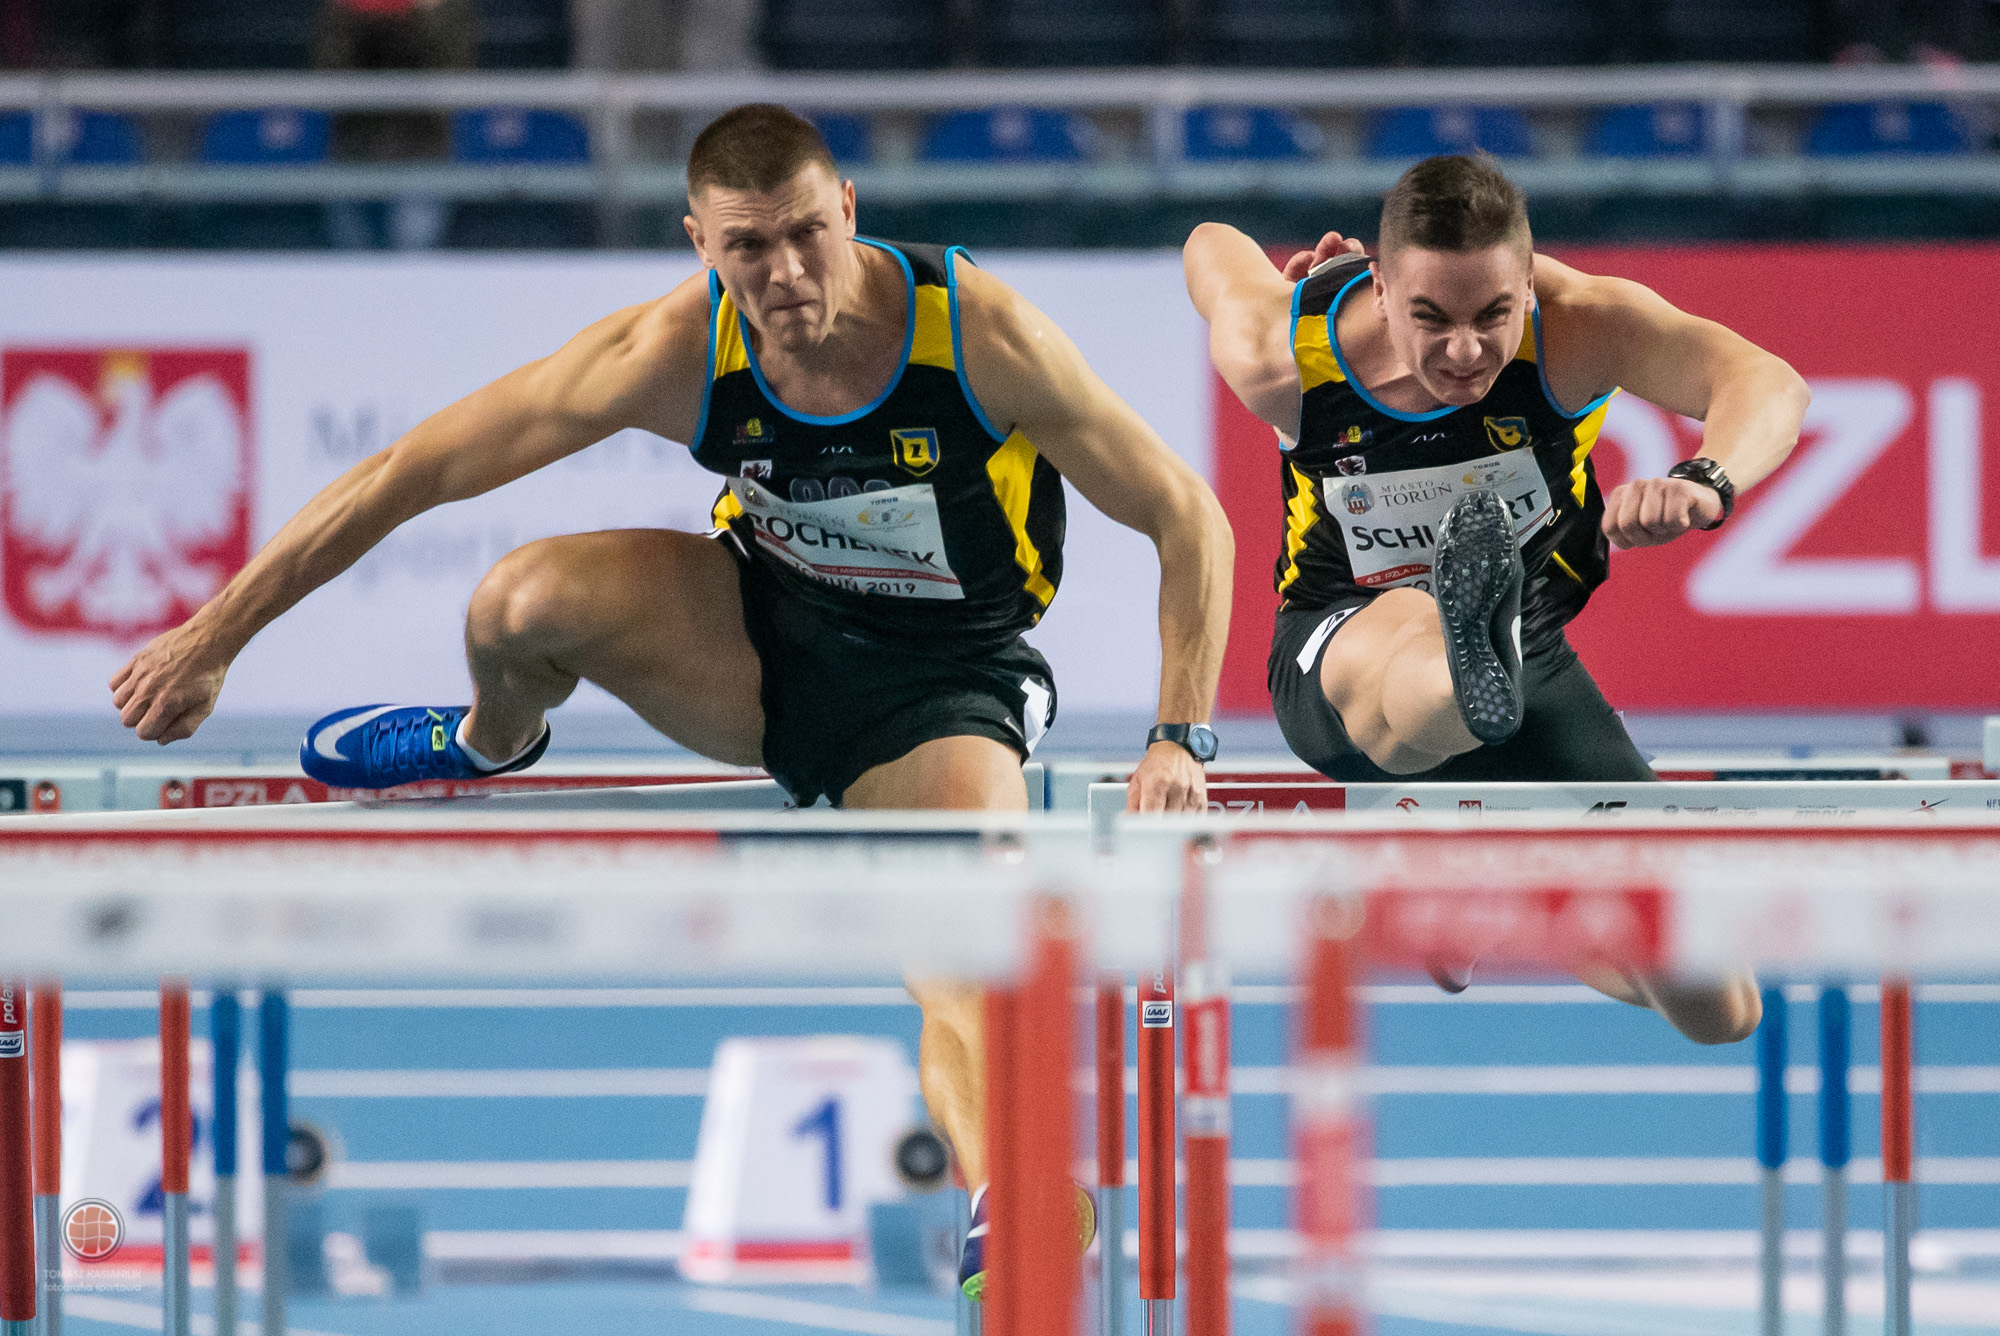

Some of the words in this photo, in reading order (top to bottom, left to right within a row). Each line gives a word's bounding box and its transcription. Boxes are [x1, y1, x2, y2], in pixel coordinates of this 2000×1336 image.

[1381, 480, 1434, 493] MIASTO
[1380, 482, 1453, 508] TORUŃ
[1352, 490, 1537, 551] SCHRT
[866, 581, 916, 596] 2019
[1147, 1008, 1169, 1016] IAAF
[0, 1037, 21, 1046] AAF
[791, 1095, 843, 1211] 1
